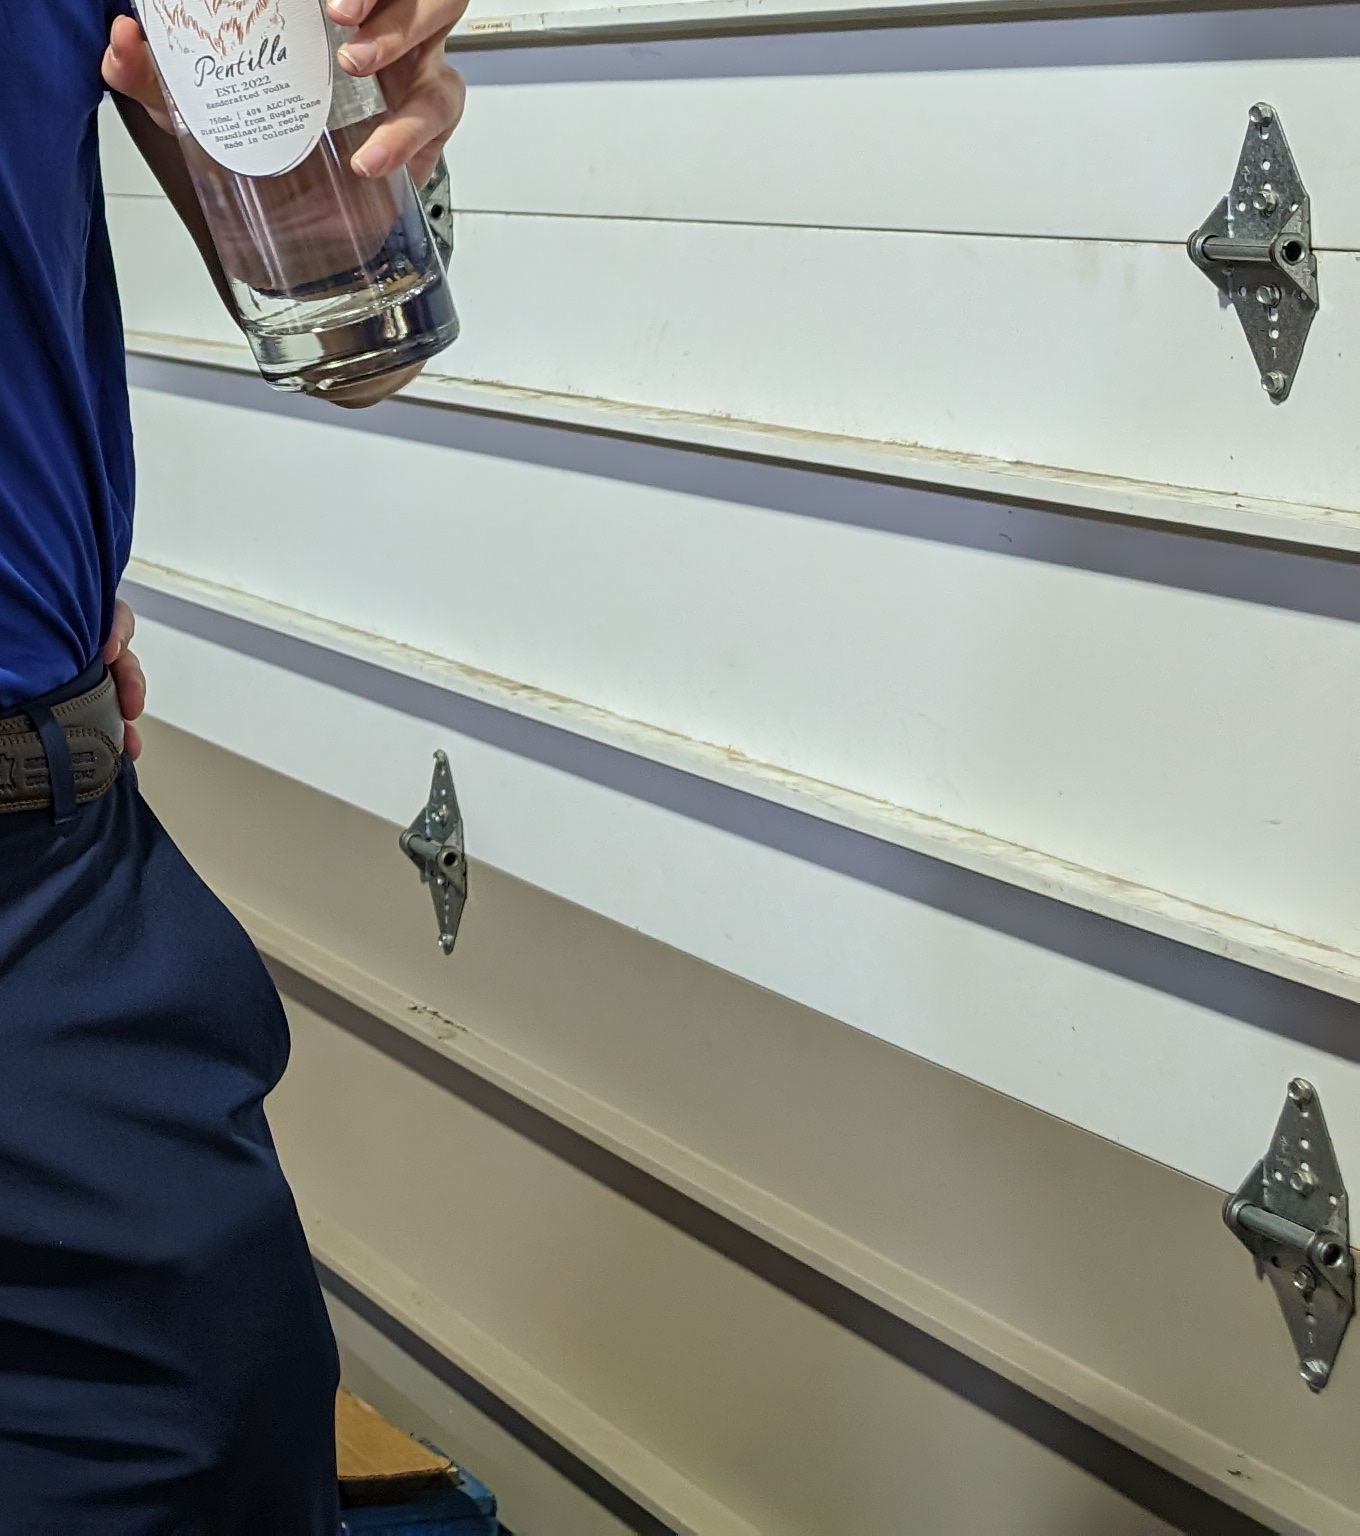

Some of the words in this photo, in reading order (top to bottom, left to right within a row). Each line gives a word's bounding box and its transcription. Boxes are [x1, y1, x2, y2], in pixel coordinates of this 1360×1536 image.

[194, 34, 287, 87] Pentilla
[206, 90, 260, 110] Handcrafted
[263, 82, 291, 95] Vodka
[215, 85, 240, 98] EST.
[242, 75, 272, 92] 2022
[200, 122, 240, 136] Distilled
[244, 117, 267, 128] from
[269, 107, 296, 121] Sugar
[300, 98, 322, 111] Cane
[266, 95, 305, 112] ALC/VOL
[214, 124, 274, 143] Scandinavian
[278, 112, 310, 127] recipe
[224, 139, 244, 150] Made
[262, 123, 306, 141] Colorado
